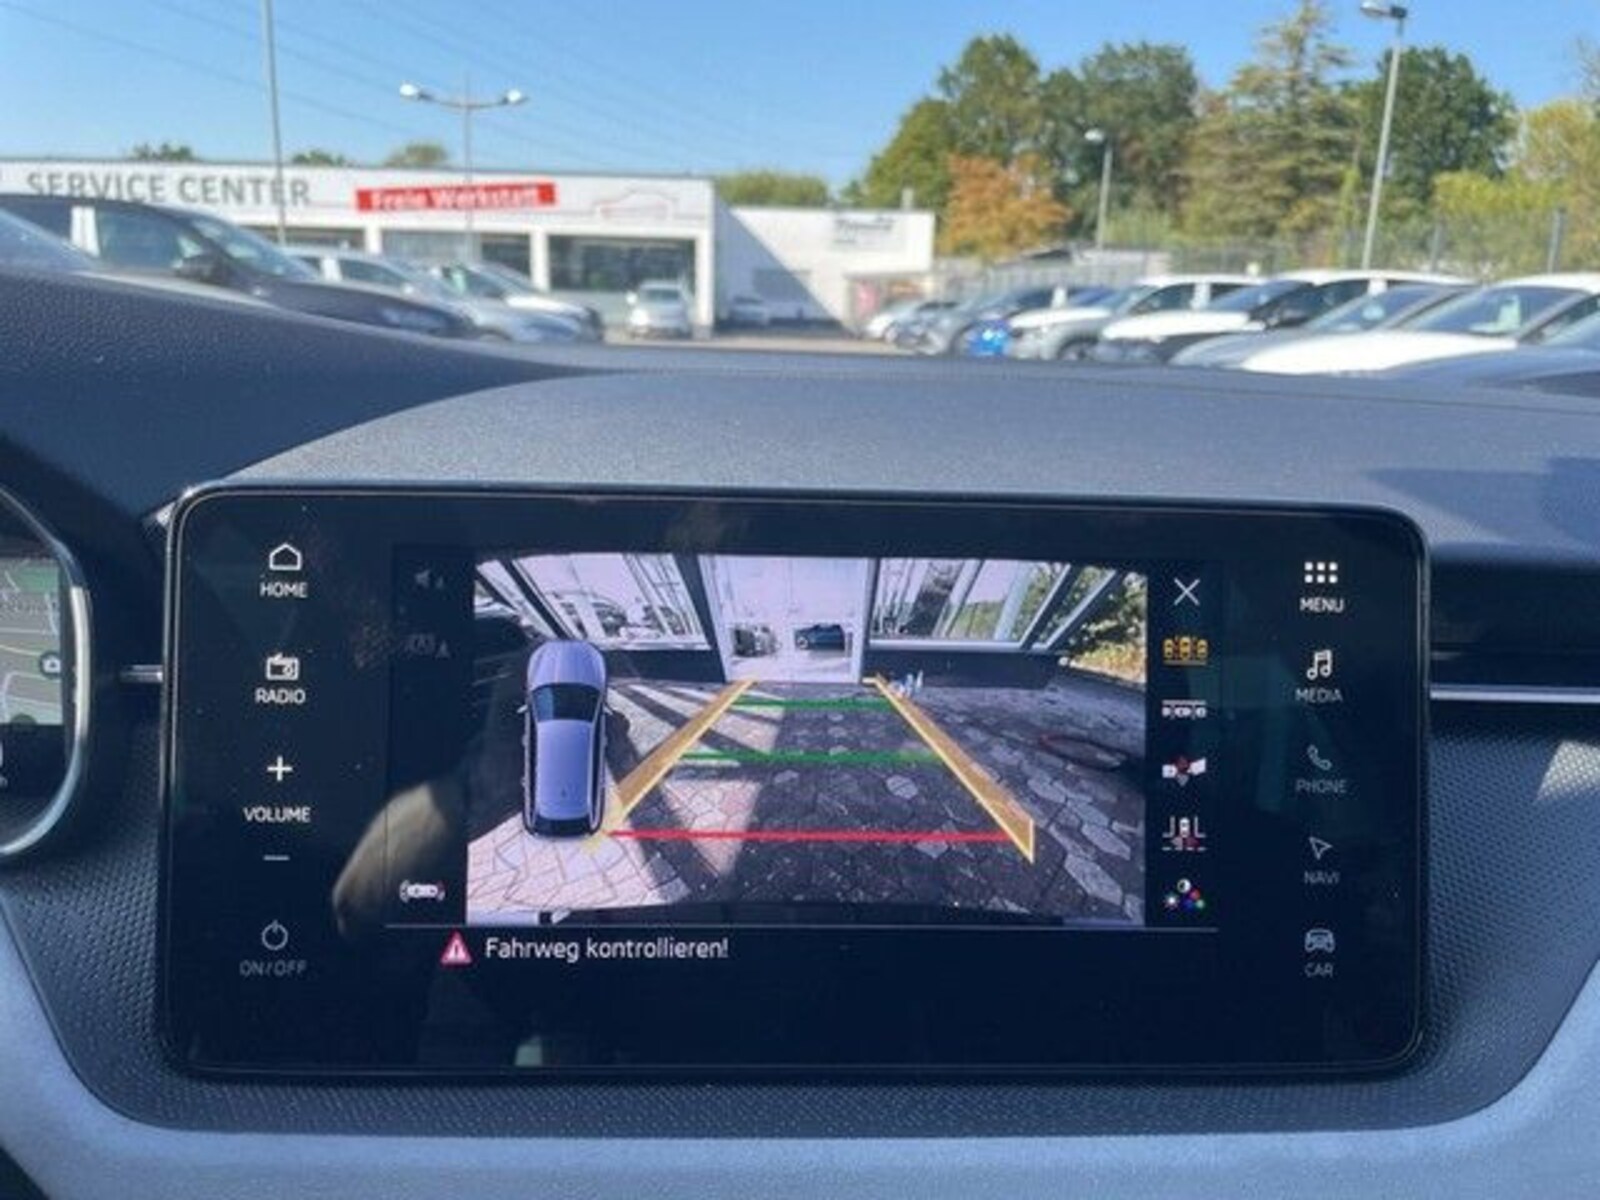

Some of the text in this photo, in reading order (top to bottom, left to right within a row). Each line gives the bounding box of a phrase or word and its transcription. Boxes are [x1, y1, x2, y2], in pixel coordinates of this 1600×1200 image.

[26, 171, 164, 202] SERVICE
[177, 176, 310, 204] CENTER
[259, 581, 308, 598] HOME
[1299, 598, 1345, 614] MENU
[254, 687, 306, 705] RADIO
[1295, 687, 1343, 704] MEDIA
[1295, 779, 1347, 795] PHONE
[243, 806, 312, 823] VOLUME
[1303, 871, 1341, 886] NAVI
[485, 937, 729, 963] Fahrweg kontrollieren!
[239, 959, 307, 977] ON/OFF
[1303, 962, 1334, 978] CAR
